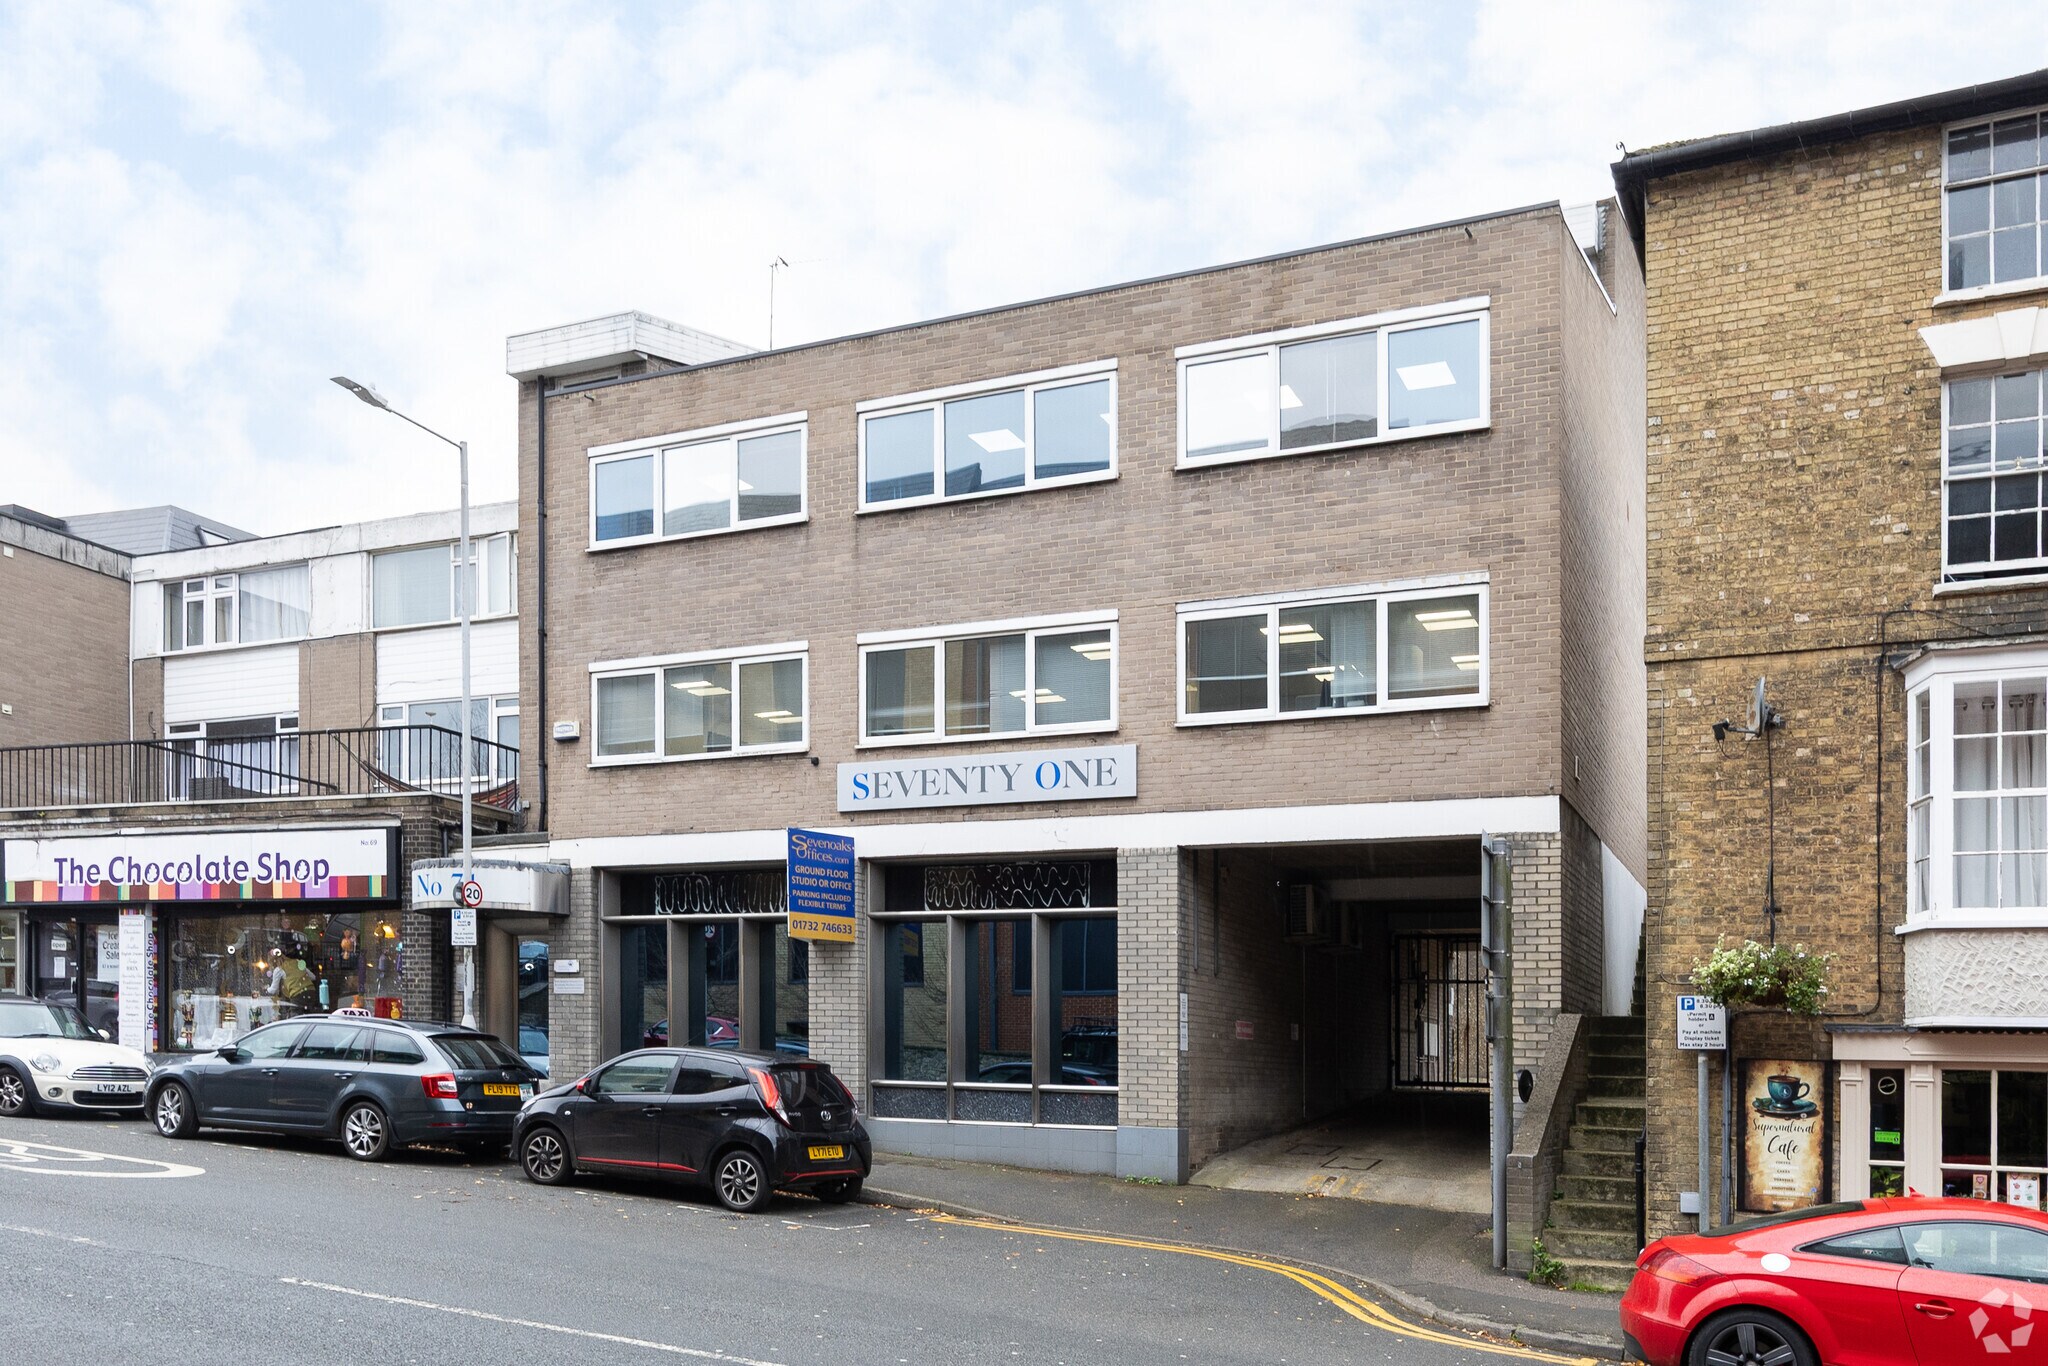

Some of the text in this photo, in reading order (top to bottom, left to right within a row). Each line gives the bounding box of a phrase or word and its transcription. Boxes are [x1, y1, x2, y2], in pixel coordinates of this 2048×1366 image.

[853, 757, 1118, 801] SEVENTY ONE
[370, 838, 378, 846] 69
[792, 834, 852, 852] Sevenoaks
[796, 846, 850, 865] Offices.com
[54, 852, 330, 886] The Chocolate Shop
[795, 865, 849, 879] GROUND FLOOR
[417, 873, 443, 897] No
[791, 876, 852, 891] STUDIO OR OFFICE
[465, 887, 480, 900] 20
[792, 889, 852, 903] PARKING INCLUDED
[798, 899, 847, 911] FLEXIBLE TERMS
[792, 919, 853, 935] 01732 746633
[108, 931, 118, 940] Ice
[103, 940, 119, 951] Crea
[147, 932, 155, 957] Shop
[1684, 999, 1693, 1010] P
[97, 1084, 132, 1093] LY12 AZL
[487, 1084, 504, 1094] FL19
[504, 1084, 517, 1094] TTZ
[1753, 1119, 1816, 1136] Supernatural
[1767, 1135, 1801, 1160] Cafe
